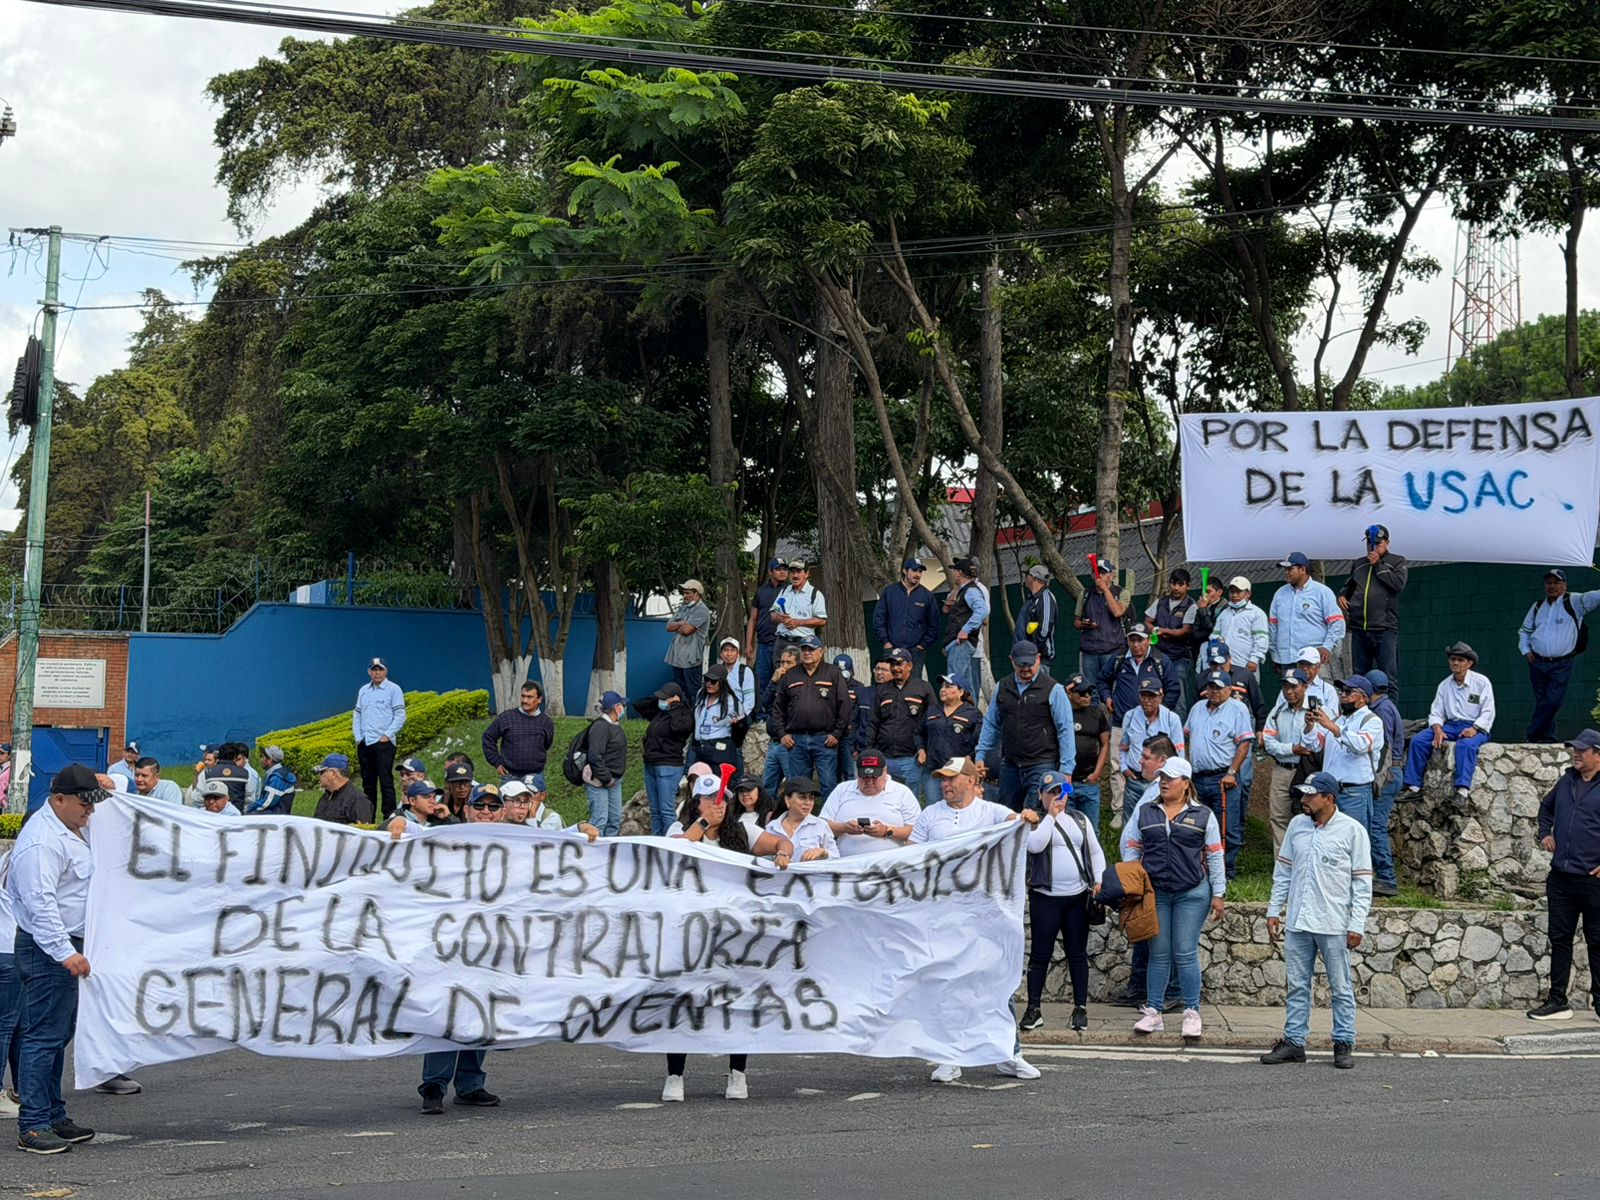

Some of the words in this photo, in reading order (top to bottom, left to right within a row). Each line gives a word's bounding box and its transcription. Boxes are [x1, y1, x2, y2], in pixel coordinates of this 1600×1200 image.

[1201, 418, 1289, 452] POR
[1313, 418, 1369, 451] LA
[1387, 407, 1592, 452] DEFENSA
[1246, 468, 1306, 506] DE
[1331, 468, 1381, 506] LA
[127, 811, 192, 881] EL
[215, 823, 509, 903] FINIQUITO
[529, 841, 589, 898] ES
[608, 842, 706, 895] UNA
[212, 895, 306, 957] DE
[322, 895, 396, 960] LA
[431, 908, 810, 978] CONTRALORIA
[135, 965, 417, 1045] GENERAL
[443, 984, 522, 1046] DE
